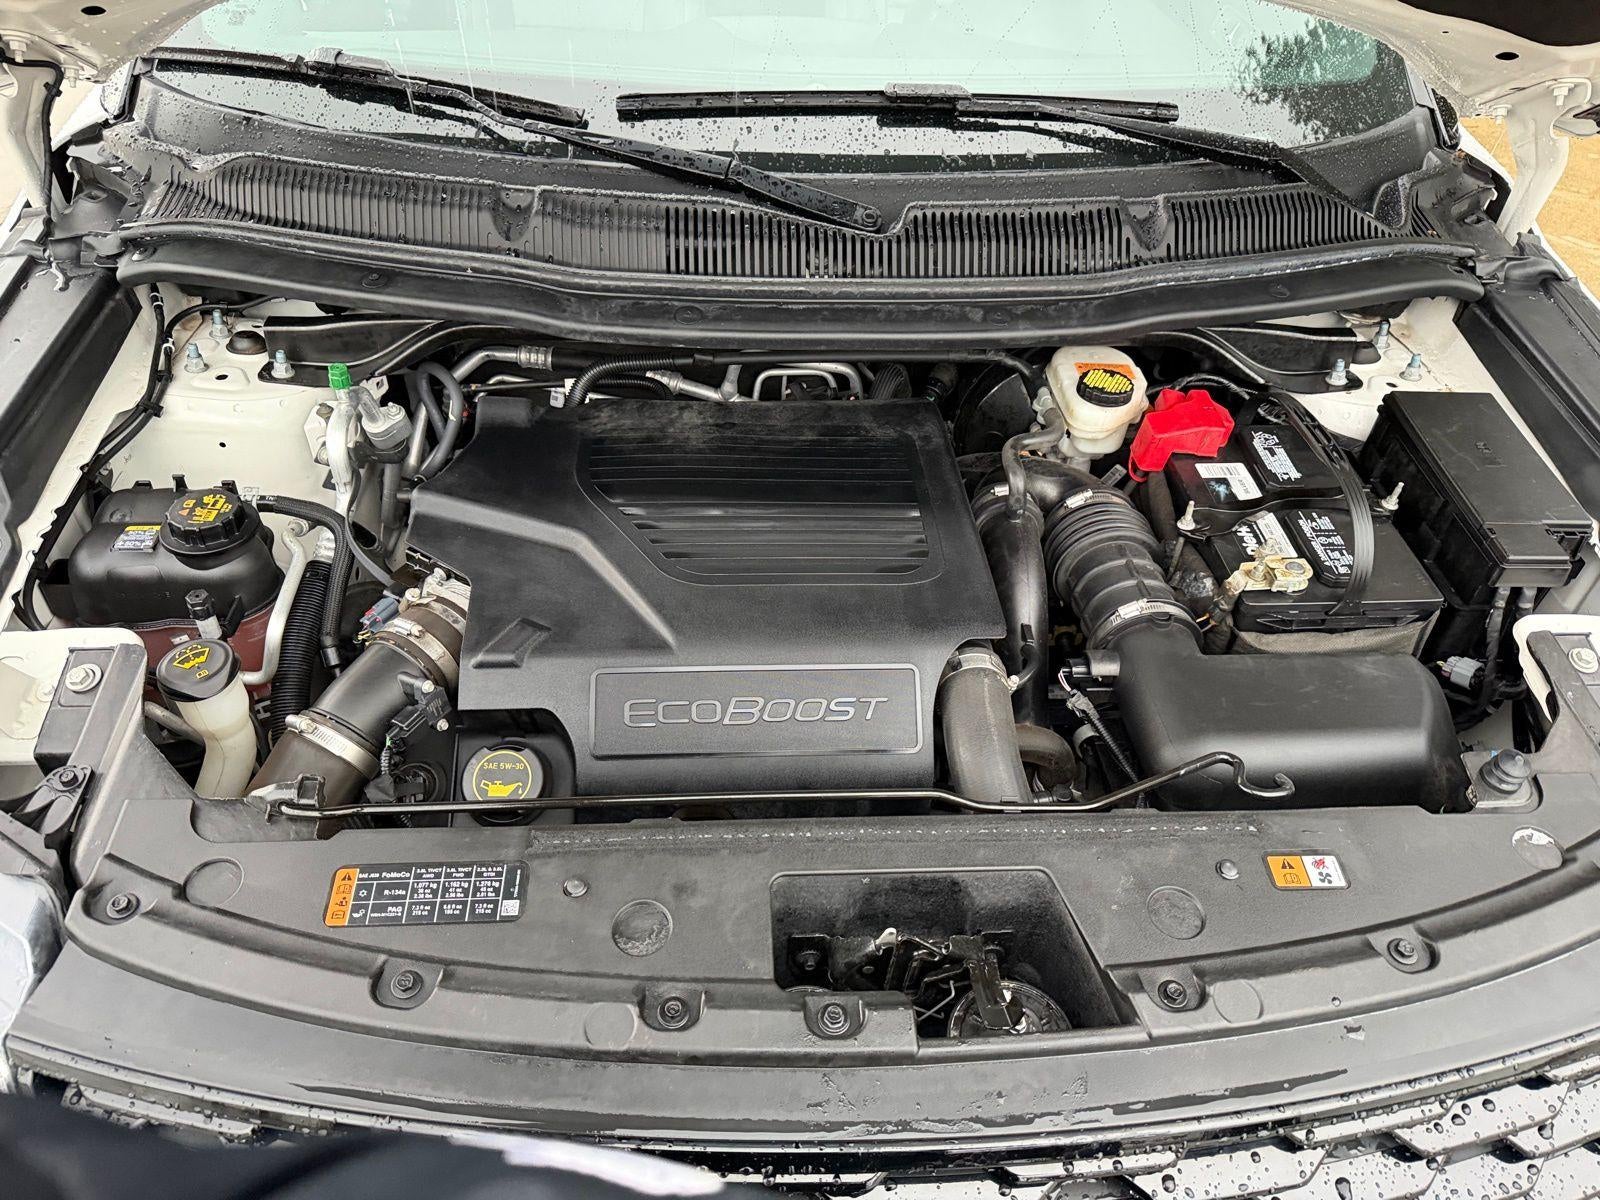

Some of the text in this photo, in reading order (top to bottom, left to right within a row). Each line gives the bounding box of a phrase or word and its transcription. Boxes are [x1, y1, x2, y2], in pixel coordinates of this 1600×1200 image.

[483, 762, 525, 770] SAE 5W-30
[381, 871, 411, 879] FoMoCo
